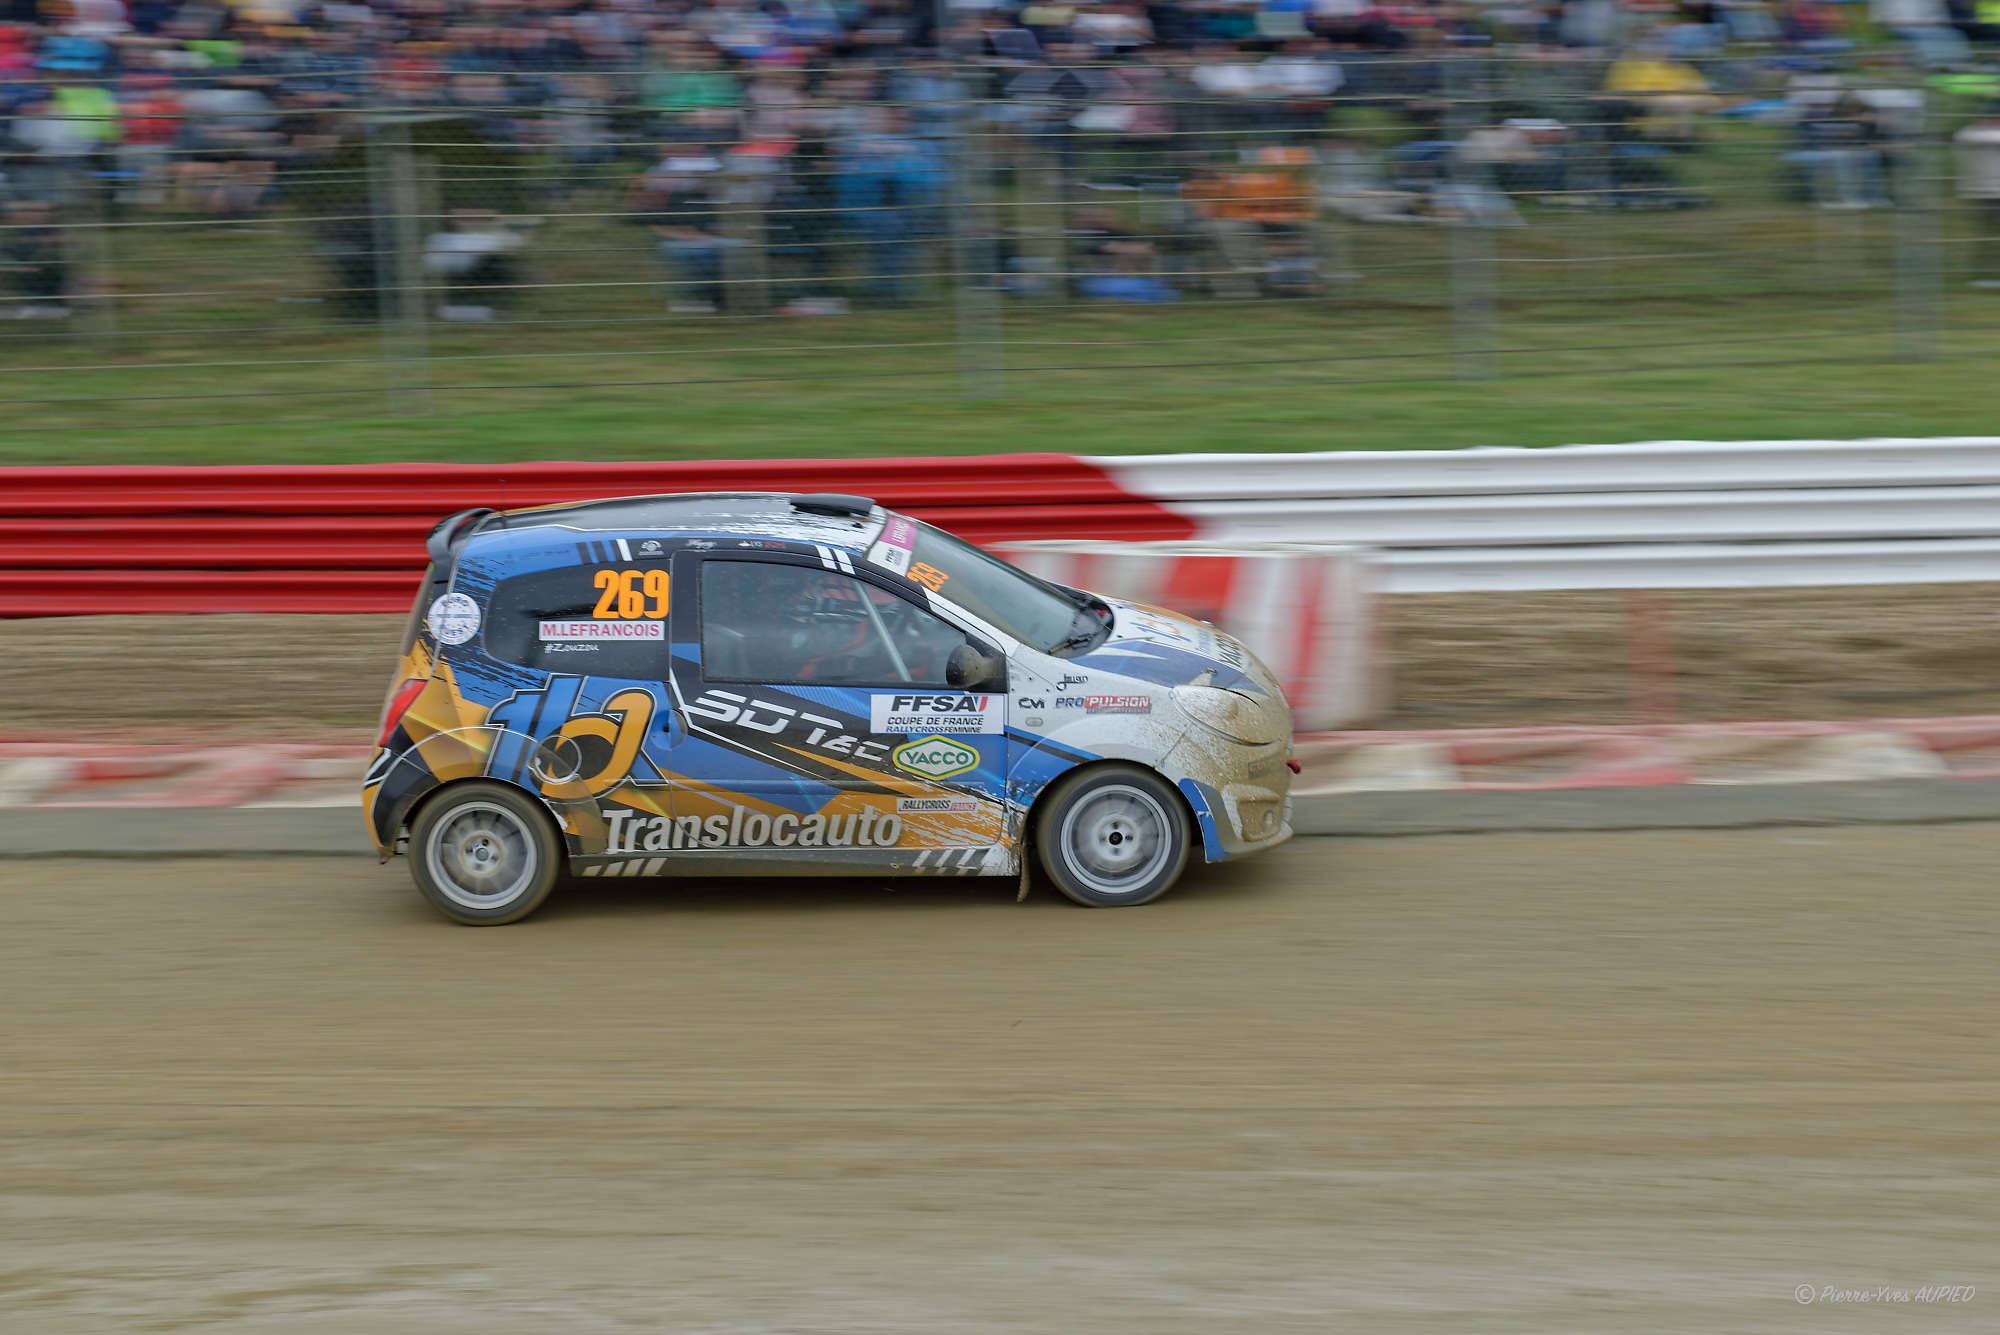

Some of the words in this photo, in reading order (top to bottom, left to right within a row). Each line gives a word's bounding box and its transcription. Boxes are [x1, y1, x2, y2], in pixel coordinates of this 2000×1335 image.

[907, 561, 950, 593] 269
[592, 569, 670, 619] 269
[542, 623, 660, 637] M.LEFRANCOIS
[891, 695, 977, 712] FFSA
[887, 716, 923, 725] COUPE
[926, 717, 941, 725] DE
[943, 717, 984, 725] FRANCE
[904, 751, 969, 765] YACCO
[902, 800, 951, 810] RALLYCROSS
[602, 804, 901, 854] Translocauto
